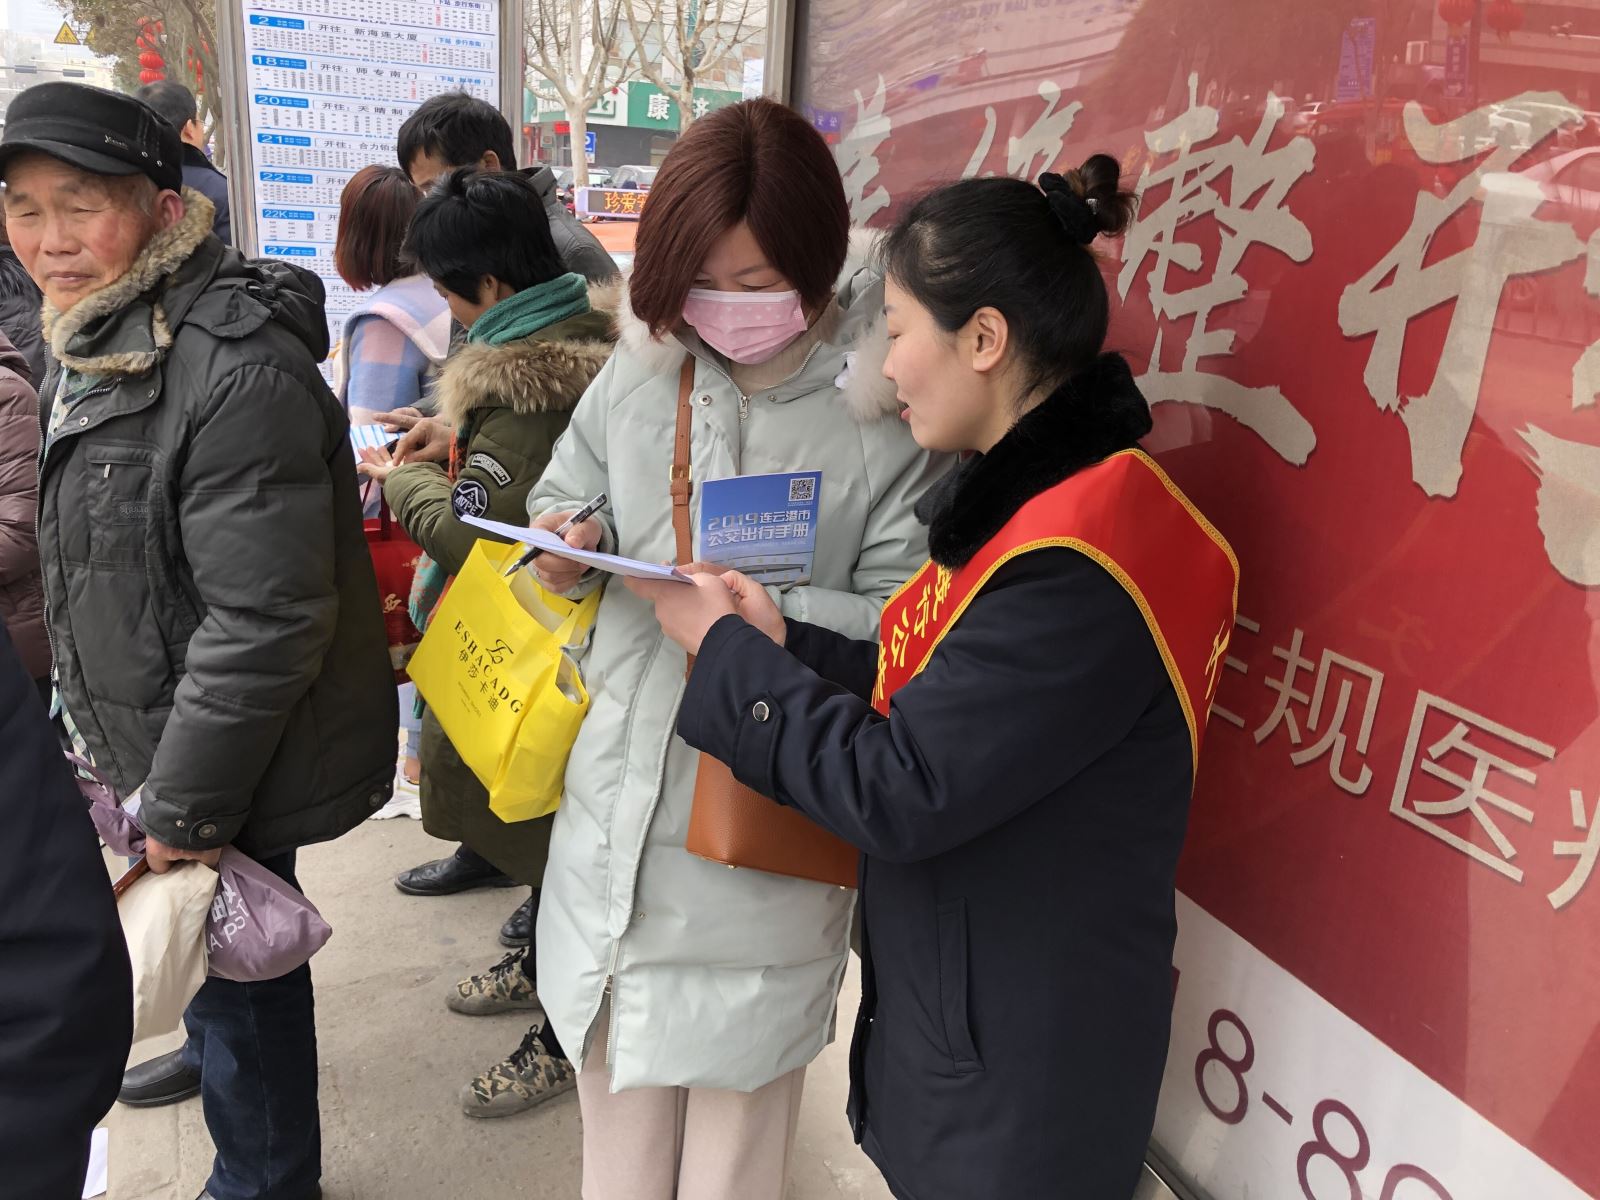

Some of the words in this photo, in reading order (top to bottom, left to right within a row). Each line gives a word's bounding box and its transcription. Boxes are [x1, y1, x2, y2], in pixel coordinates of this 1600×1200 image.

[258, 16, 270, 26] 2
[255, 56, 278, 66] 18
[257, 95, 281, 106] 20
[261, 134, 284, 144] 21
[262, 172, 285, 183] 22
[264, 209, 290, 219] 22K
[267, 246, 289, 256] 27
[707, 522, 810, 547] 公交出行手册
